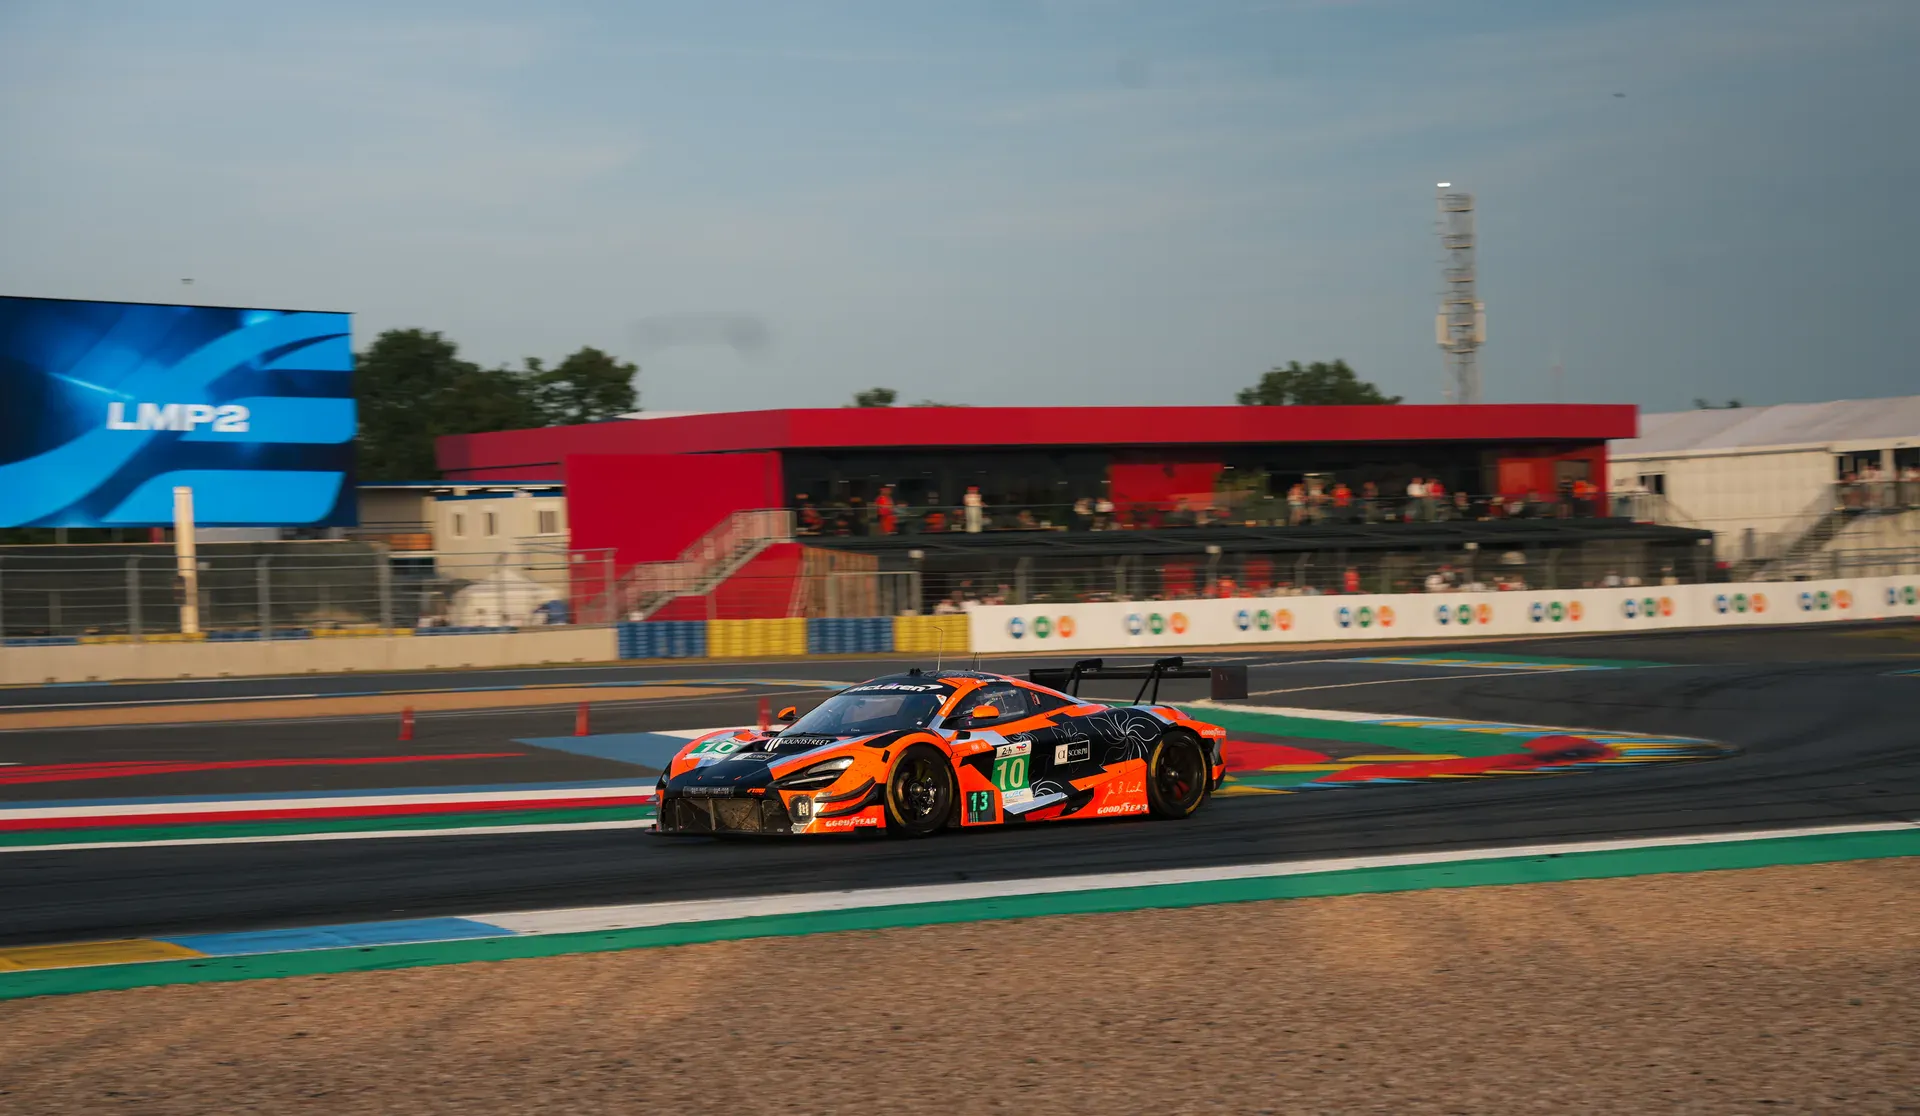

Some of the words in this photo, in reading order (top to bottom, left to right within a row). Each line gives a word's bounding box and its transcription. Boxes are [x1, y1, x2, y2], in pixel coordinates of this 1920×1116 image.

[106, 402, 250, 432] LMP2
[700, 741, 739, 754] 10
[997, 758, 1025, 790] 10
[971, 791, 989, 812] 13
[1097, 802, 1148, 815] GOODYEAR
[825, 816, 878, 828] GOODYEAR
